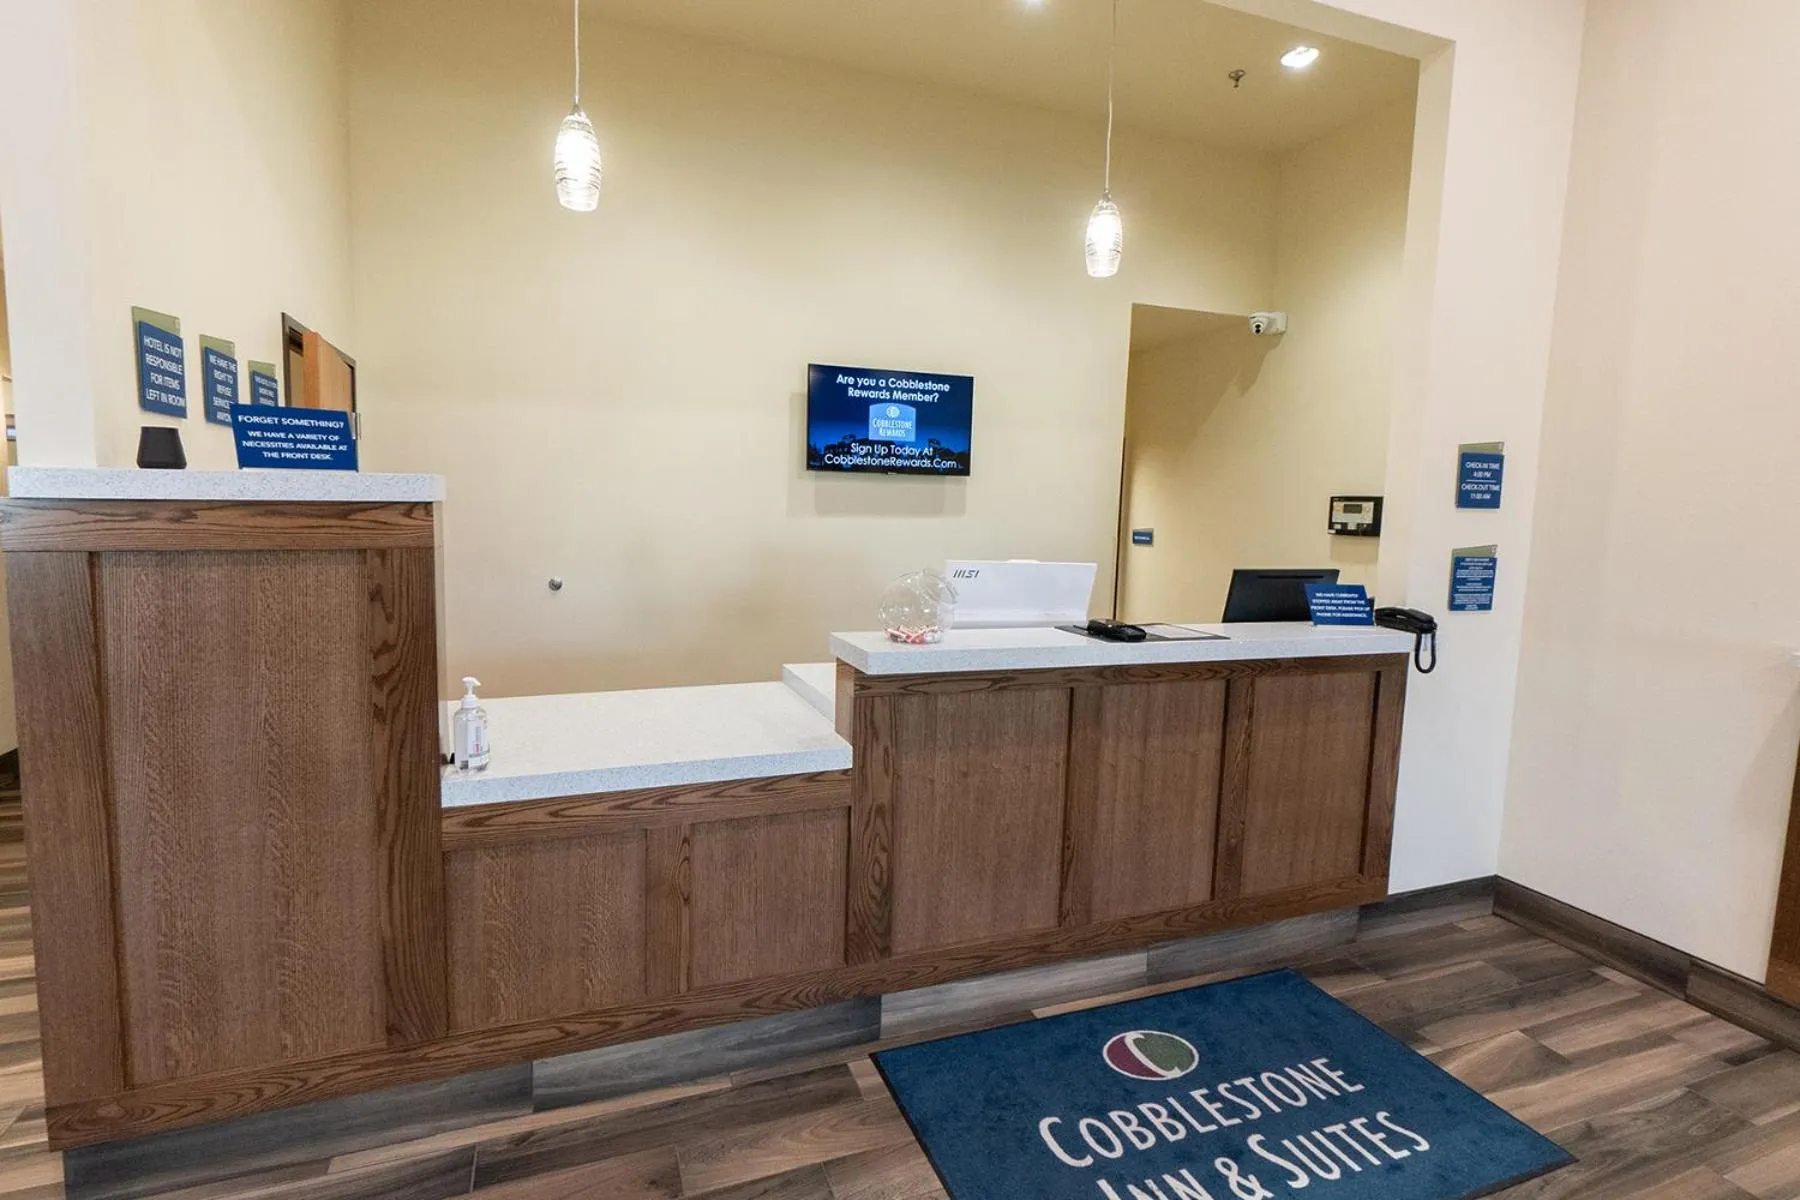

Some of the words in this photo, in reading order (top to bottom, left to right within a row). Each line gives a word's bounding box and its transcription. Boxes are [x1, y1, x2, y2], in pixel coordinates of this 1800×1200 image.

[143, 335, 163, 353] HOTEL
[163, 342, 170, 354] IS
[169, 345, 182, 359] NOT
[145, 353, 183, 375] RESPONSIBLE
[209, 354, 217, 366] WE
[216, 357, 229, 370] HAVE
[228, 360, 237, 373] THE
[150, 372, 162, 386] FOR
[163, 375, 180, 391] ITEMS
[227, 373, 234, 385] TO
[836, 373, 855, 385] Are
[856, 378, 876, 389] you
[878, 379, 886, 387] a
[888, 378, 951, 392] Cobblestone
[146, 387, 160, 401] LEFT
[160, 391, 168, 404] IN
[167, 393, 187, 409] ROOM
[847, 387, 890, 400] Rewards
[892, 391, 939, 403] Member?
[238, 414, 279, 425] FORGET
[281, 417, 344, 429] SOMETHING?
[872, 418, 913, 430] COBBLESTONE
[247, 430, 262, 438] WE
[263, 431, 287, 440] HAVE
[287, 432, 295, 440] A
[295, 433, 327, 441] VARIETY
[328, 434, 341, 442] OF
[879, 428, 906, 438] REWARDS
[242, 440, 295, 449] NECESSITIES
[296, 443, 337, 451] AVAILABLE
[338, 444, 348, 452] AT
[850, 443, 872, 456] Sign
[874, 444, 889, 456] Up
[890, 445, 920, 457] Today
[922, 448, 934, 457] At
[262, 451, 281, 459] THE
[281, 451, 310, 460] FRONT
[310, 452, 334, 461] DESK.
[823, 453, 957, 469] CobblestoneRewards.Com
[1038, 1056, 1365, 1168] COBBLESTONE
[1214, 1156, 1275, 1200] &
[1247, 1111, 1430, 1189] SUITES
